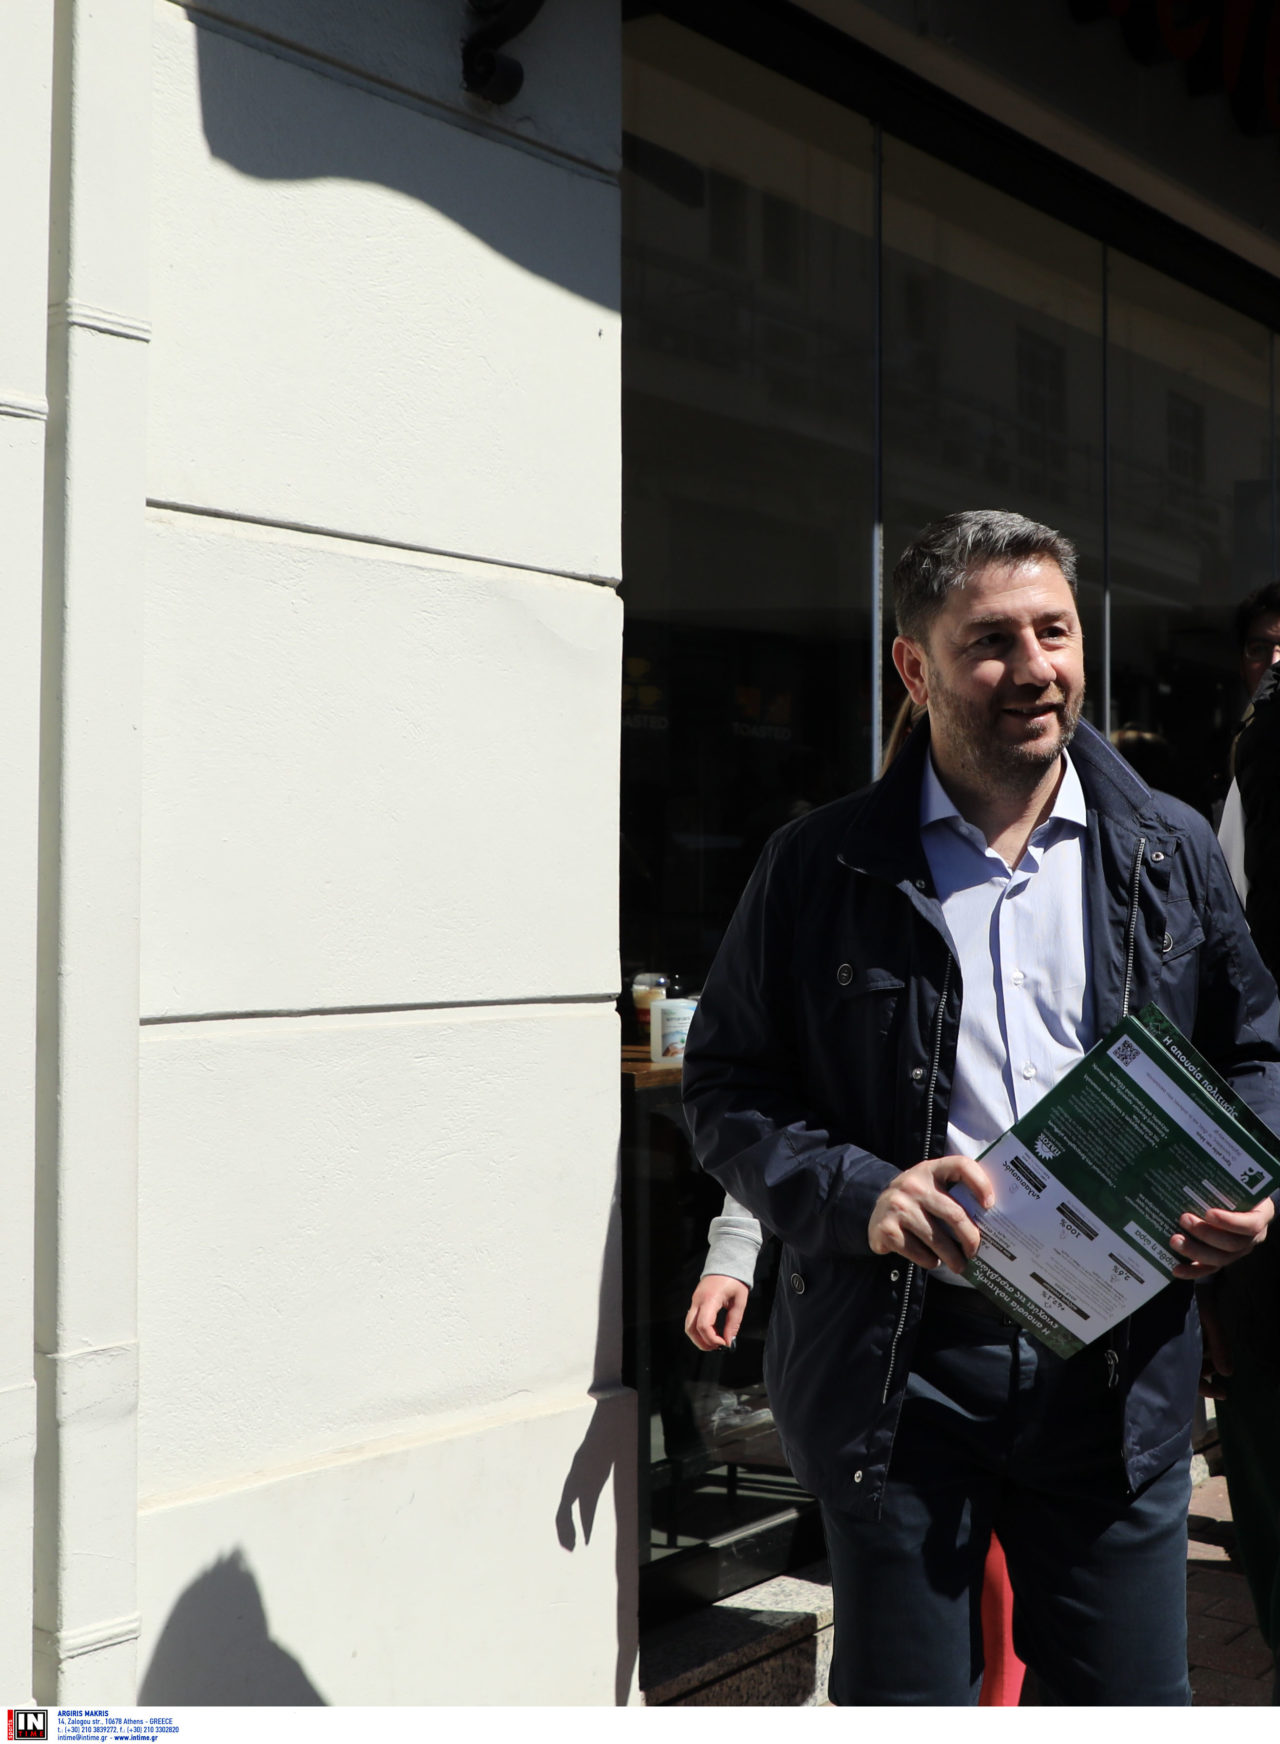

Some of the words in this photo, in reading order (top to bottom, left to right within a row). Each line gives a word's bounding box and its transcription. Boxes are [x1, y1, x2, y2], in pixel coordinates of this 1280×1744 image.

[624, 714, 669, 730] ASTED
[1041, 1135, 1059, 1155] ΠΑΣΟΚ
[1060, 1218, 1081, 1238] 100%
[1134, 1229, 1151, 1246] ώρα
[972, 1258, 1015, 1293] στρεβλώσε
[1113, 1265, 1130, 1281] 2,6%
[973, 1268, 1011, 1302] πολιτικής
[1014, 1290, 1027, 1302] τις
[1010, 1302, 1043, 1329] απουσία
[1026, 1302, 1058, 1329] ενισχύει
[1041, 1327, 1051, 1335] Η
